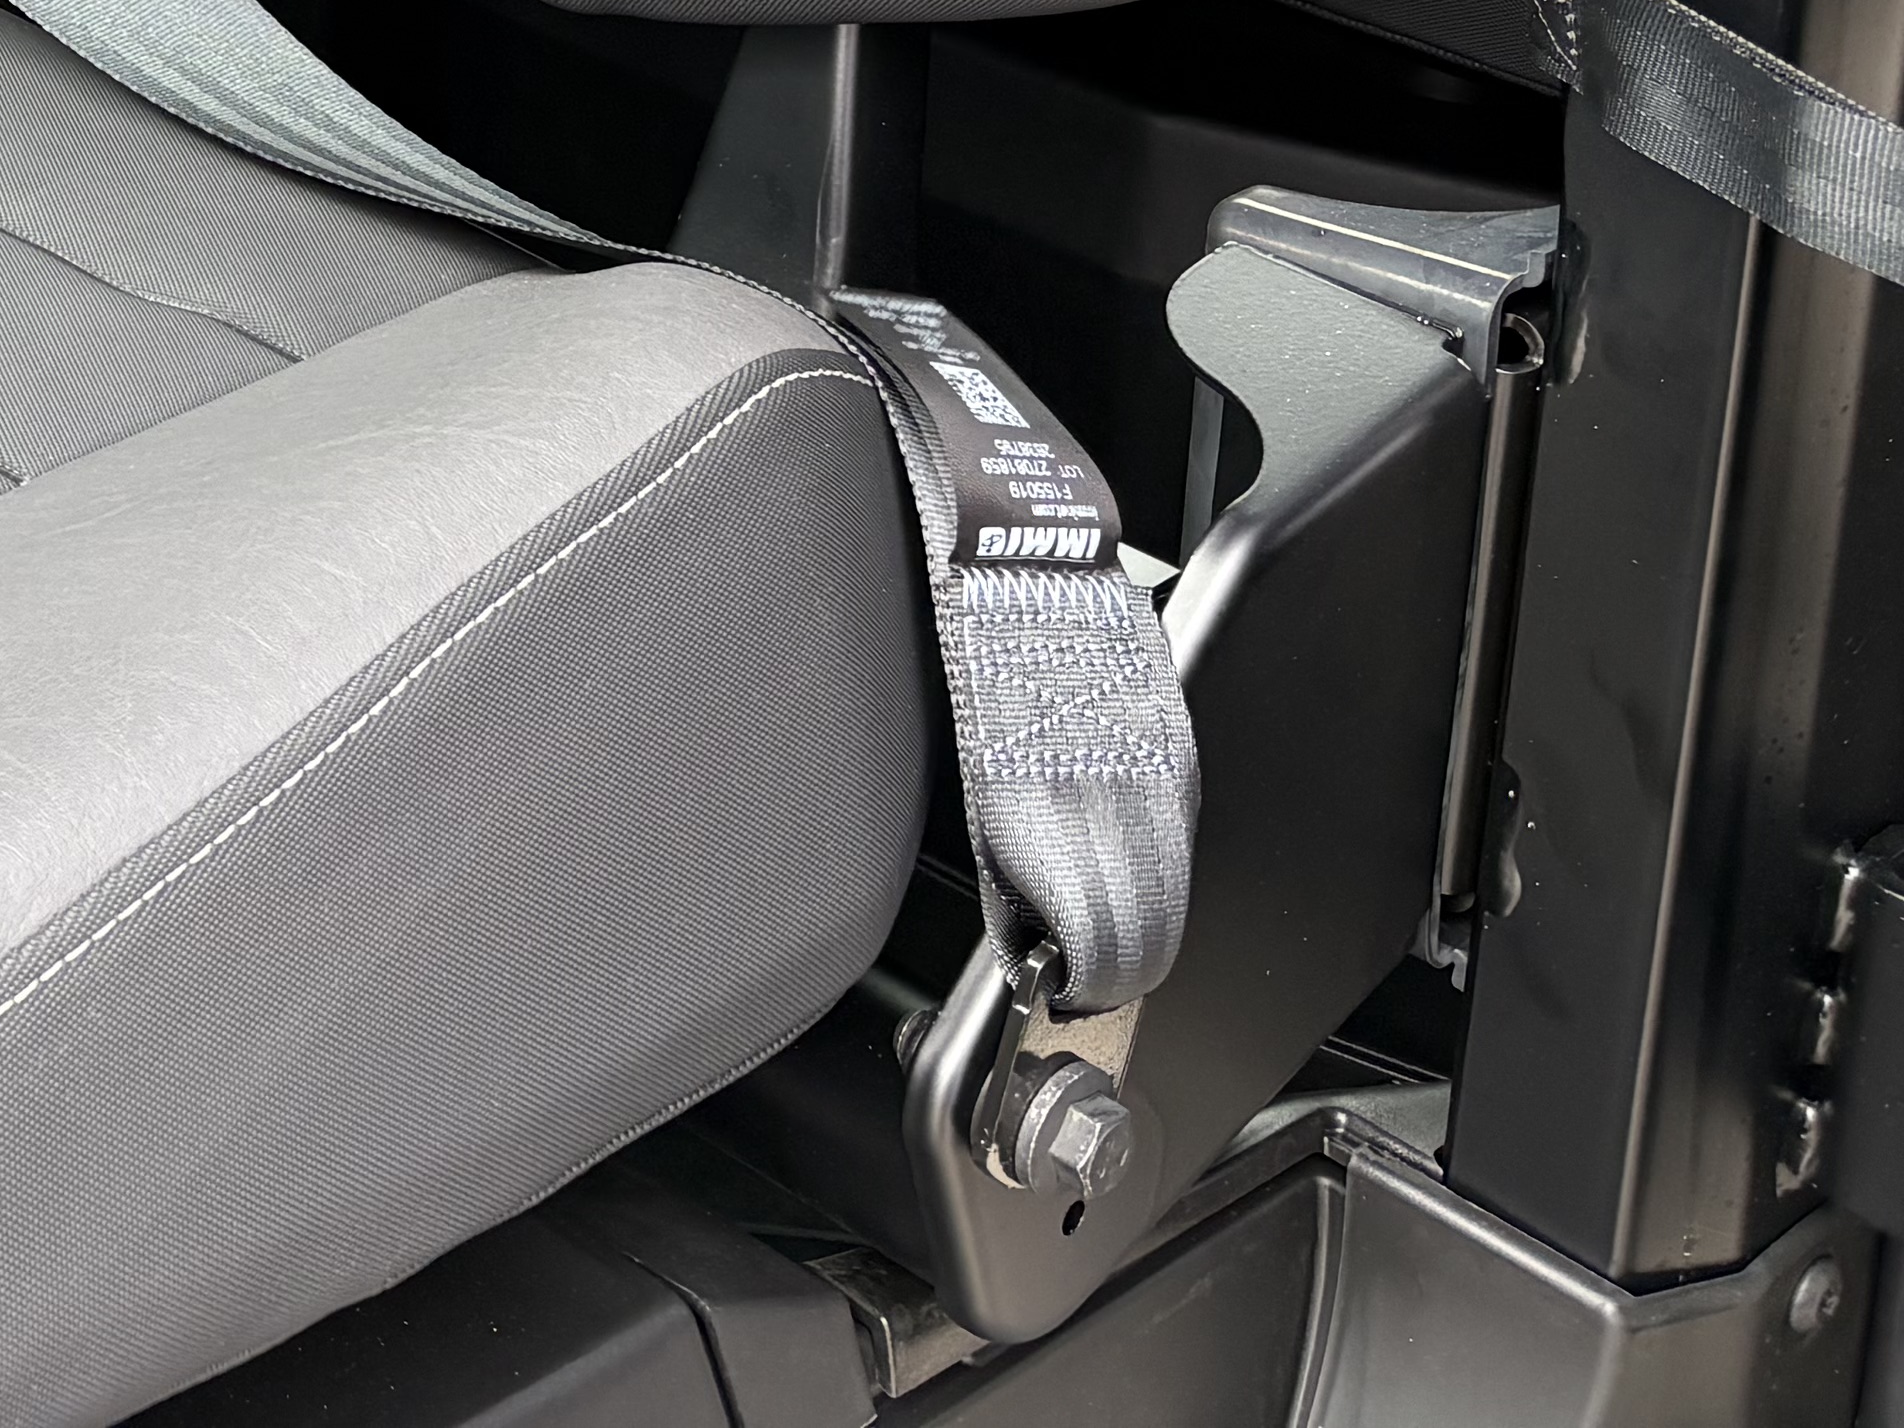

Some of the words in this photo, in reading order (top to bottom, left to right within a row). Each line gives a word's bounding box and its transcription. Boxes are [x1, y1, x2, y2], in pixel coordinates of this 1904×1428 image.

[1058, 465, 1084, 478] LOT
[1010, 482, 1073, 499] F155019
[1005, 527, 1101, 558] IMMI
